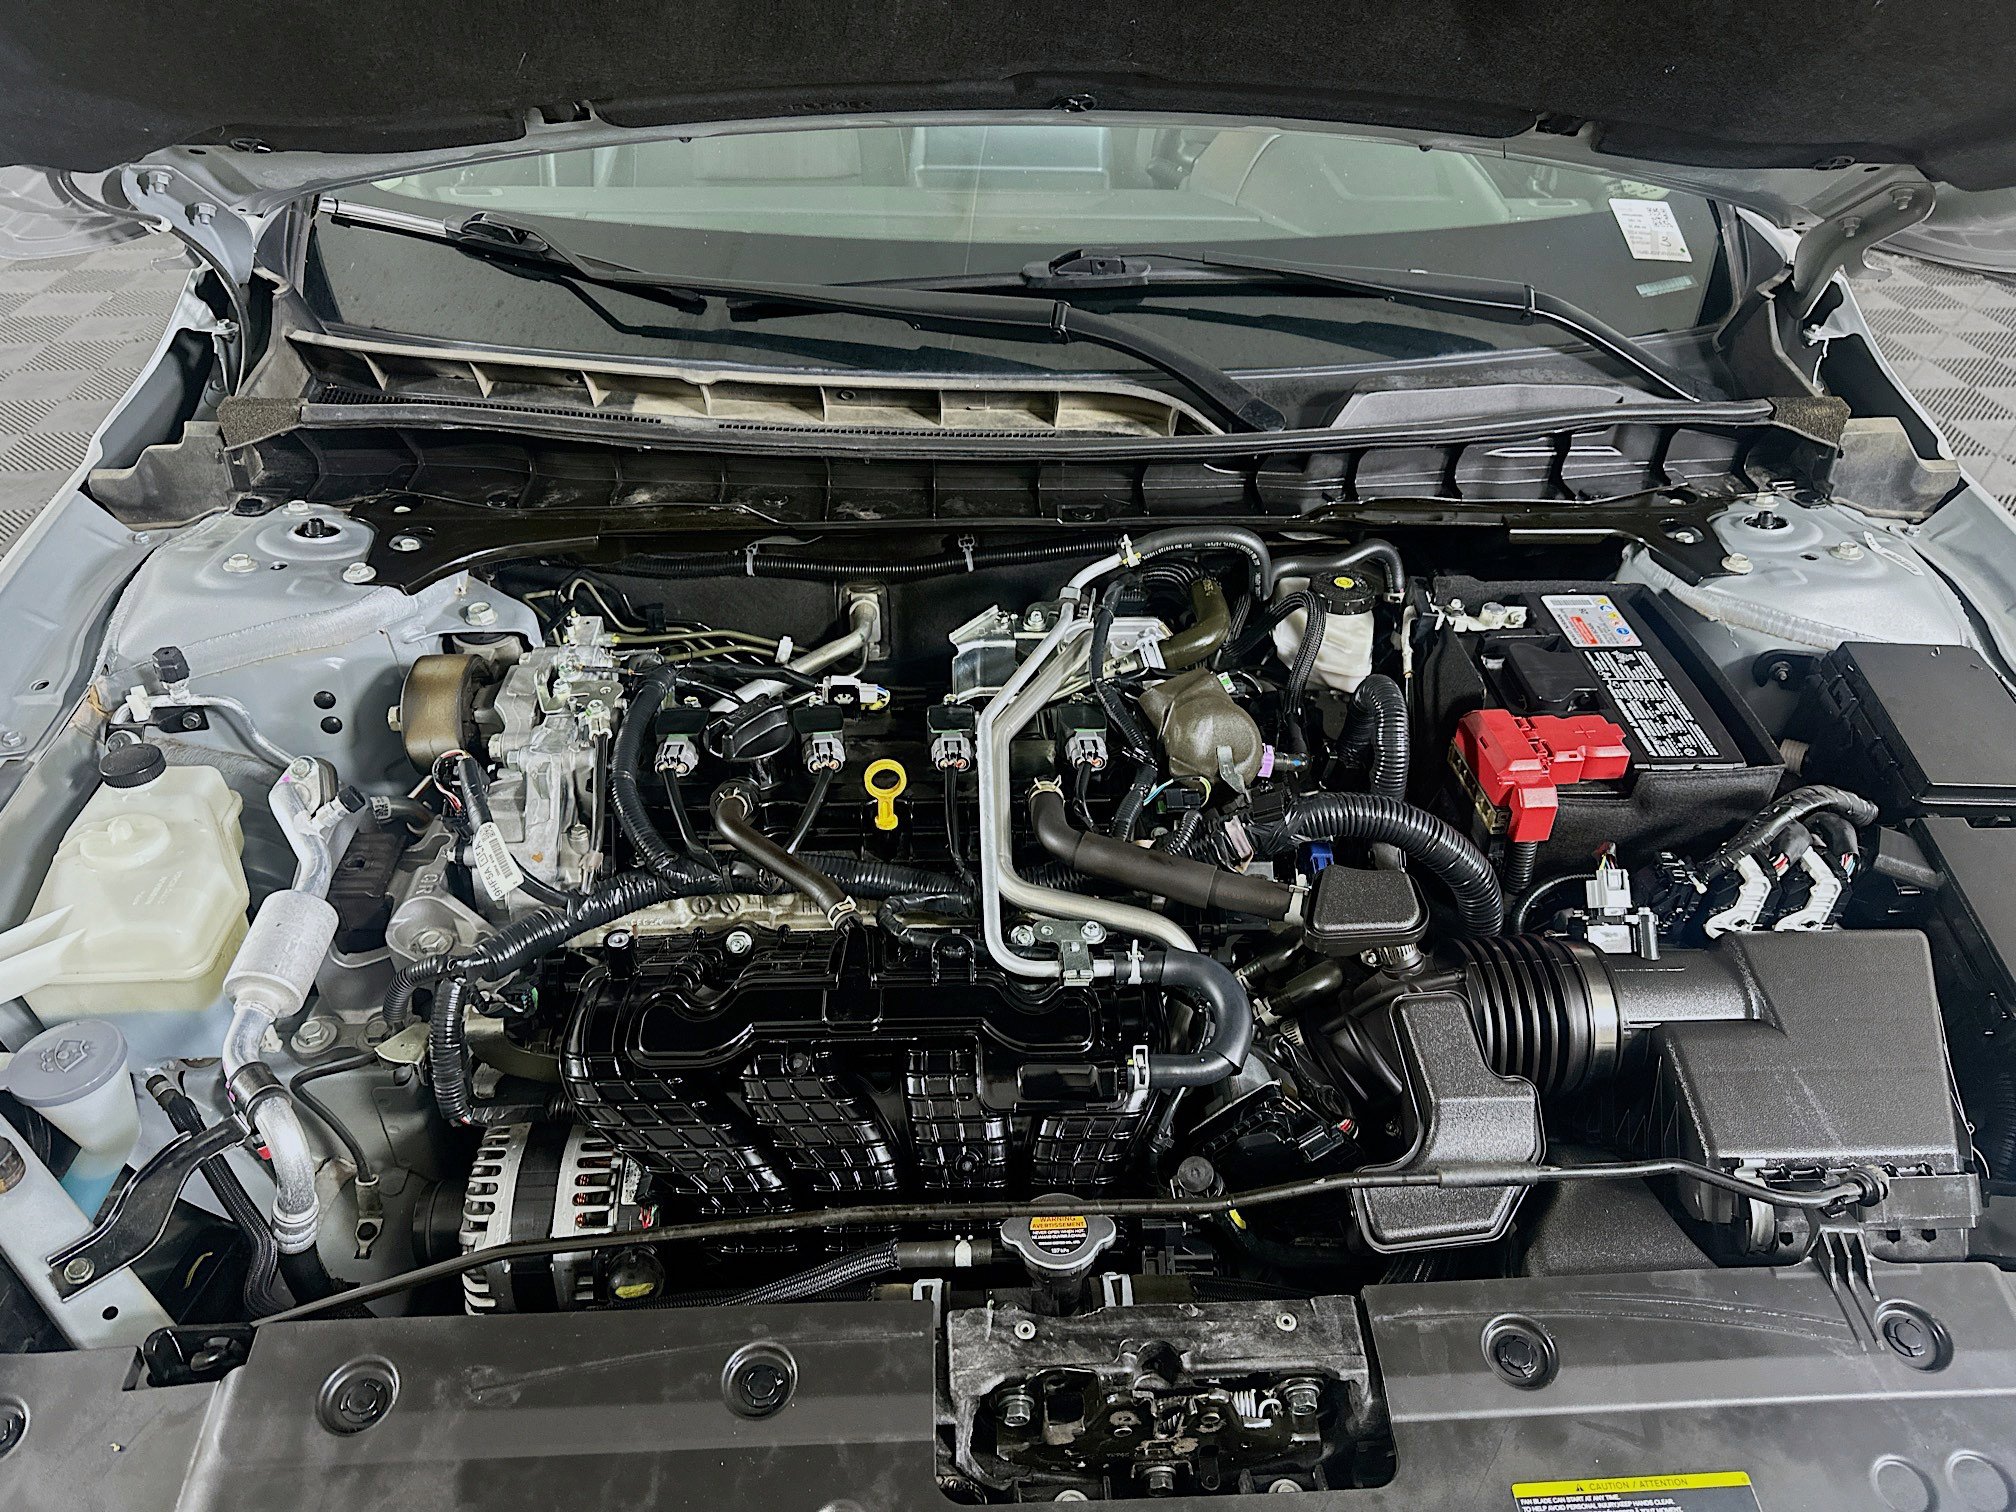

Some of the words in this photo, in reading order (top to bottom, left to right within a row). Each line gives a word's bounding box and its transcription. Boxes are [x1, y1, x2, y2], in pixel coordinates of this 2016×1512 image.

[484, 867, 502, 896] 9HF5A
[1589, 1481, 1629, 1491] CAUTION
[1639, 1478, 1688, 1488] ATTENTION
[1532, 1497, 1552, 1505] BLADE
[1566, 1495, 1584, 1503] START
[1565, 1502, 1598, 1511] PERSONAL
[1633, 1498, 1654, 1507] HANDS
